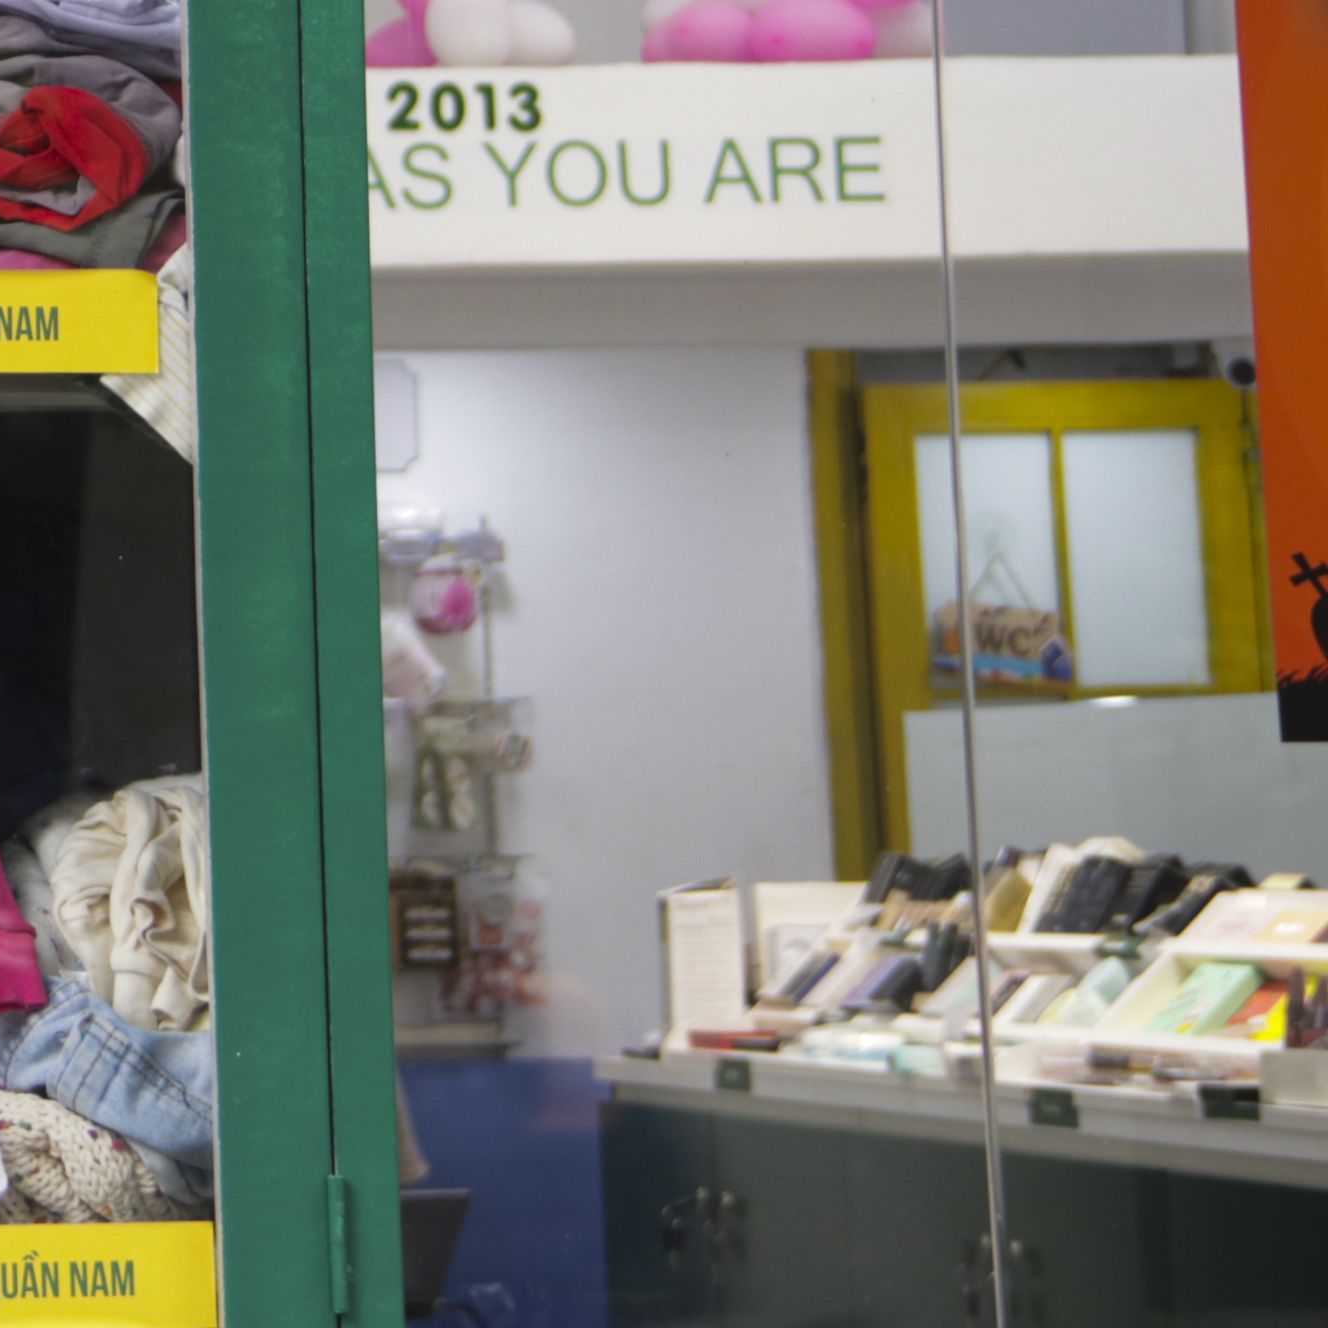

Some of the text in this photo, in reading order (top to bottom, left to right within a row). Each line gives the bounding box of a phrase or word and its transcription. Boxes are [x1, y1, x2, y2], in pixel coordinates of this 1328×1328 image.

[386, 80, 543, 133] 2013
[481, 137, 674, 208] YOU
[702, 133, 889, 206] ARE
[975, 622, 1032, 657] WC
[67, 1258, 137, 1299] NAM
